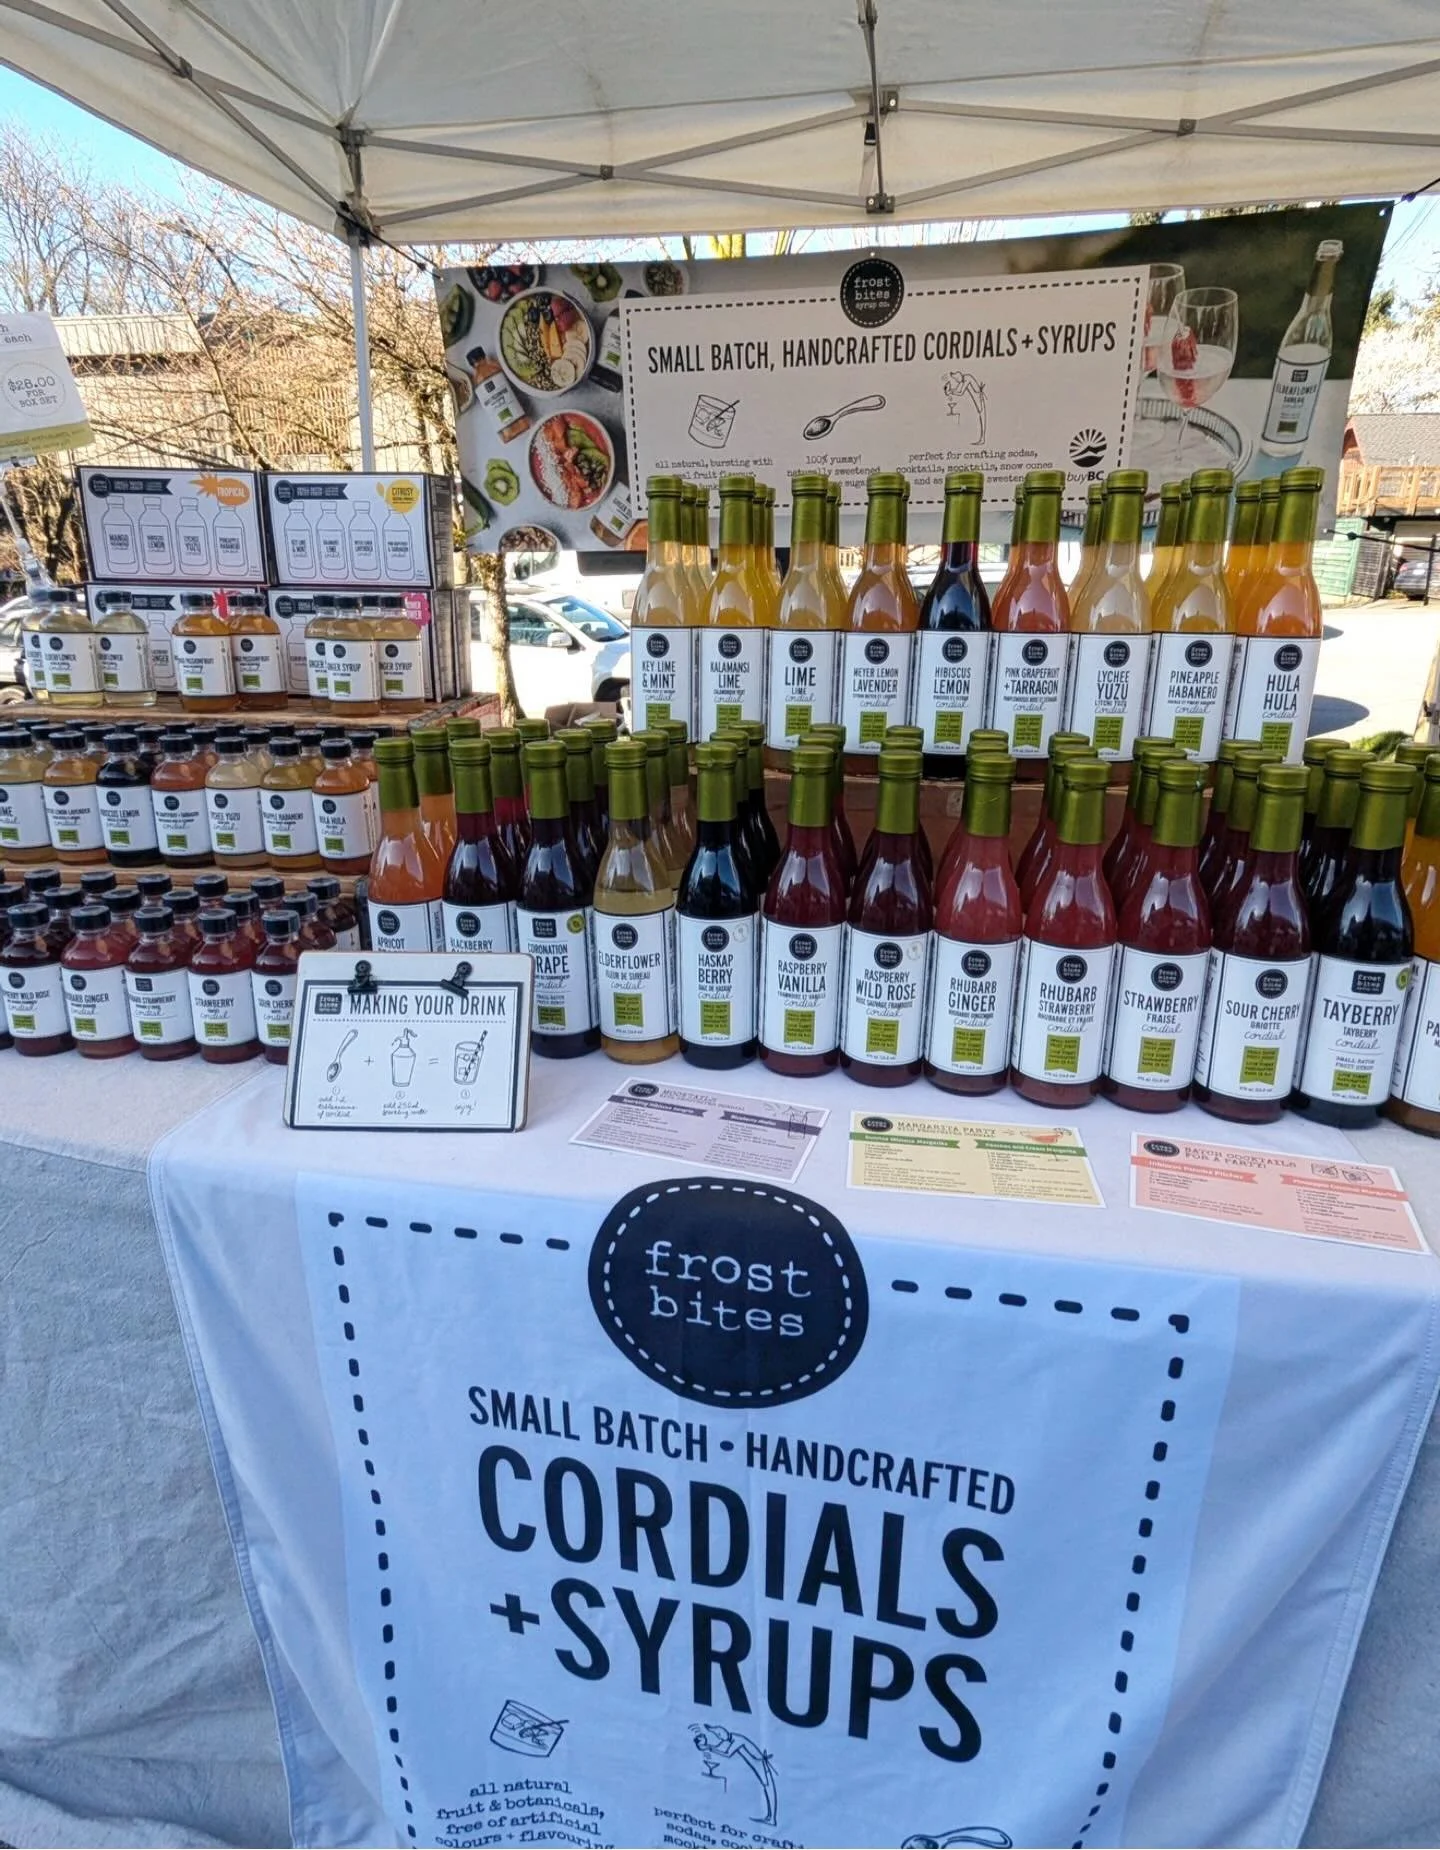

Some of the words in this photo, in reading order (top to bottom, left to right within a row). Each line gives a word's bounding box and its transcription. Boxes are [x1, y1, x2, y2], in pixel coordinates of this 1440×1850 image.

[854, 275, 891, 289] frost
[854, 288, 889, 301] bites
[647, 344, 705, 374] SMALL
[711, 341, 775, 373] BATCH,
[782, 333, 916, 368] HANDCRAFTED
[7, 376, 56, 393] $28.00
[25, 389, 46, 397] FOR
[19, 397, 38, 408] BOX
[39, 395, 58, 405] SET
[656, 460, 668, 469] all
[672, 460, 709, 470] natural,
[710, 458, 752, 470] bursting
[753, 457, 773, 467] with
[806, 455, 829, 465] 100%
[909, 452, 944, 464] perfect
[946, 451, 961, 461] for
[963, 449, 1006, 462] crafting
[1008, 449, 1038, 460] sodas,
[835, 465, 880, 476] sweetened
[896, 464, 945, 476] cocktails,
[1000, 461, 1024, 471] snow
[1025, 460, 1054, 470] cones
[844, 479, 866, 489] suga
[914, 476, 930, 486] and
[391, 487, 414, 497] CITRUSY
[642, 660, 657, 672] KEY
[658, 661, 676, 672] LIME
[710, 661, 750, 674] KALAMANSI
[853, 667, 875, 677] MEYER
[876, 667, 899, 678] LEMON
[935, 666, 971, 679] HIBISCUS
[1005, 667, 1020, 677] PINK
[1021, 667, 1060, 679] GRAPEFRUIT
[642, 674, 648, 688] &
[650, 673, 675, 689] MINT
[718, 674, 741, 688] LIME
[785, 666, 817, 687] LIME
[1097, 669, 1130, 684] LYCHEE
[1170, 670, 1220, 685] PINEAPPLE
[1266, 674, 1300, 693] HULA
[791, 687, 807, 695] LIME
[852, 679, 898, 693] LAVENDER
[933, 680, 970, 695] LEMON
[1097, 683, 1129, 700] YUZU
[1168, 684, 1217, 699] HABANERO
[1263, 692, 1298, 711] HULA
[376, 936, 405, 949] APRICOT
[527, 942, 568, 955] CORONATION
[536, 955, 570, 974] RAPE
[598, 949, 662, 970] ELDERFLOWER
[698, 954, 734, 968] HASKAP
[777, 959, 828, 976] RASPBERRY
[698, 968, 733, 985] BERRY
[777, 974, 826, 993] VANILLA
[864, 968, 910, 984] RASPBERRY
[856, 978, 883, 1000] WILD
[887, 982, 917, 1001] ROSE
[950, 977, 997, 994] RHUBARB
[1039, 982, 1097, 1002] RHUBARB
[84, 993, 110, 1003] GINGER
[142, 994, 177, 1004] STRAWBERRY
[194, 996, 235, 1008] STRAWBERRY
[350, 994, 409, 1015] MAKING
[415, 995, 454, 1015] YOUR
[460, 994, 507, 1016] DRINK
[948, 991, 996, 1012] GINGER
[1123, 990, 1200, 1013] STRAWBERRY
[1038, 1000, 1096, 1016] STRAWBERRY
[1225, 999, 1258, 1021] SOUR
[1261, 1002, 1301, 1021] CHERRY
[1322, 997, 1400, 1026] TAYBERRY
[1146, 1013, 1177, 1024] FRAISE
[1141, 1023, 1183, 1034] cordial
[1244, 1029, 1287, 1041] cordial
[1342, 1026, 1378, 1039] TAYBERRY
[1335, 1038, 1380, 1050] cordial
[646, 1240, 813, 1299] frost
[649, 1284, 806, 1339] bites
[468, 1385, 582, 1442] SMALL
[593, 1404, 709, 1463] BATCH
[746, 1430, 1017, 1516] HANDCRAFTED
[478, 1444, 1005, 1640] CORDIALS
[469, 1781, 499, 1797] all
[503, 1778, 572, 1795] natural
[436, 1799, 485, 1820] fruit
[489, 1798, 502, 1813] &
[504, 1794, 606, 1820] botanicals,
[446, 1819, 484, 1835] free
[487, 1816, 507, 1829] of
[510, 1812, 602, 1837] artificial
[654, 1806, 717, 1832] perfect
[720, 1823, 748, 1839] for
[752, 1833, 805, 1849] craf
[666, 1821, 717, 1844] sodas,
[435, 1832, 503, 1849] colours
